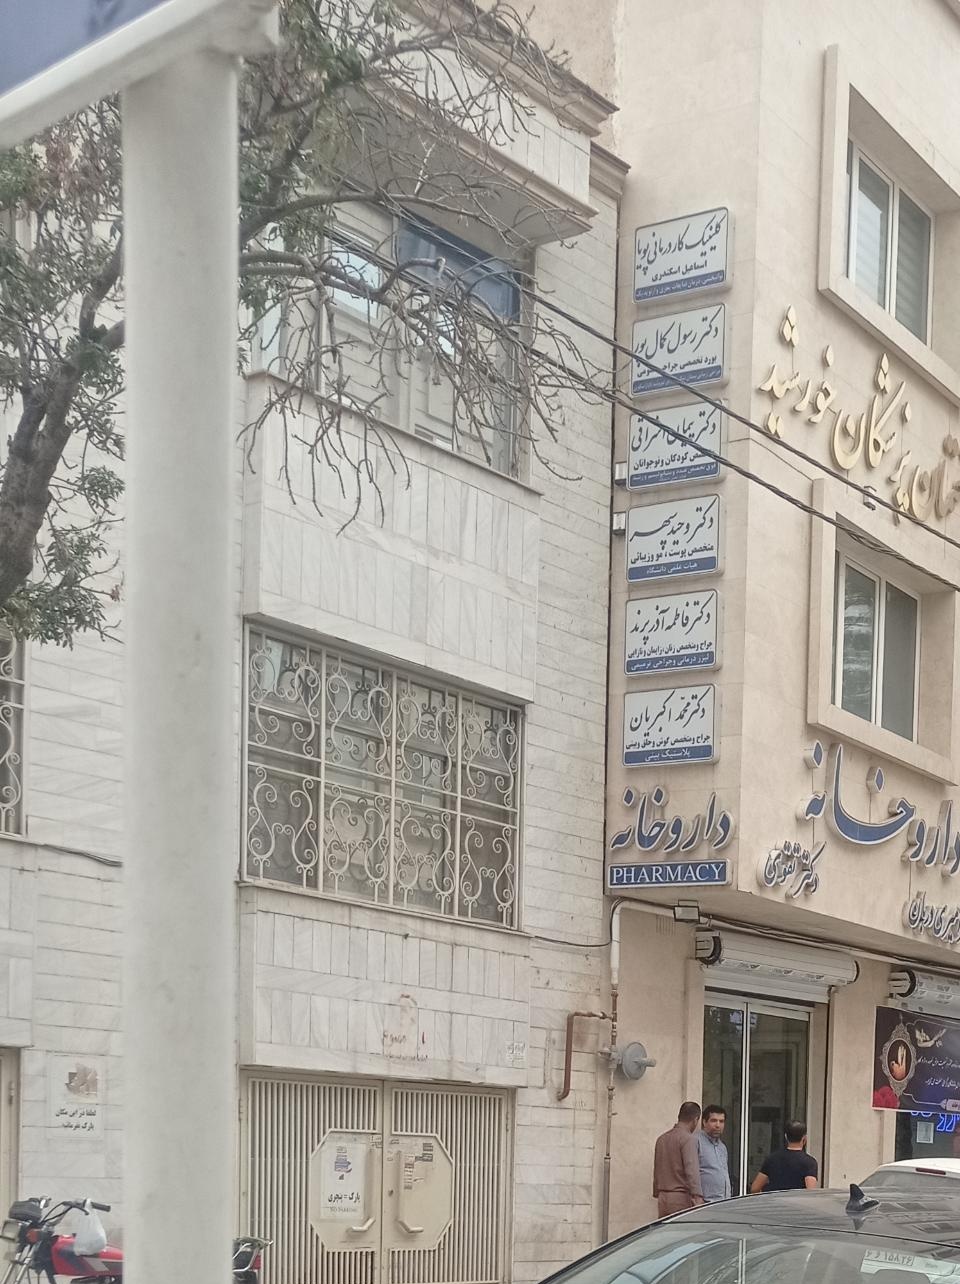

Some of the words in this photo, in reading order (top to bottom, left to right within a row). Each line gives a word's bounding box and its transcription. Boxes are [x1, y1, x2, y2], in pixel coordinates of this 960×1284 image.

[648, 224, 690, 265] کاردرمانی
[685, 214, 727, 257] کلینیک
[636, 238, 650, 276] پویا
[682, 259, 708, 275] اسماعیل
[652, 266, 680, 281] اسکندری
[667, 322, 697, 354] رسول
[693, 305, 723, 352] دکتر
[680, 356, 703, 369] تخصصی
[758, 304, 838, 438] خورشید
[695, 406, 717, 443] دکتر
[833, 353, 910, 515] پزشکان
[665, 452, 689, 466] کودکان
[629, 512, 678, 550] سپهر
[686, 496, 717, 544] دکتر
[667, 521, 690, 546] وحید
[688, 543, 714, 556] متخصص
[646, 564, 667, 575] دانشگاه
[668, 562, 682, 573] علمی
[665, 600, 689, 631] فاطمه
[685, 592, 714, 635] دکتر
[700, 640, 713, 651] جراح
[677, 655, 697, 665] درمانی
[698, 653, 709, 663] لیزر
[629, 689, 676, 737] اکبریان
[675, 696, 691, 721] محمد
[682, 687, 711, 728] دکتر
[656, 736, 669, 747] گوش
[696, 733, 711, 744] جراح
[645, 752, 660, 762] بینی
[661, 747, 690, 759] پلاستیک
[610, 785, 733, 853] داروخانه
[612, 862, 726, 884] PHARMACY
[792, 840, 827, 898] دکتر
[82, 1121, 95, 1131] پارک
[328, 1193, 343, 1204] پنچری
[349, 1192, 361, 1204] پارک
